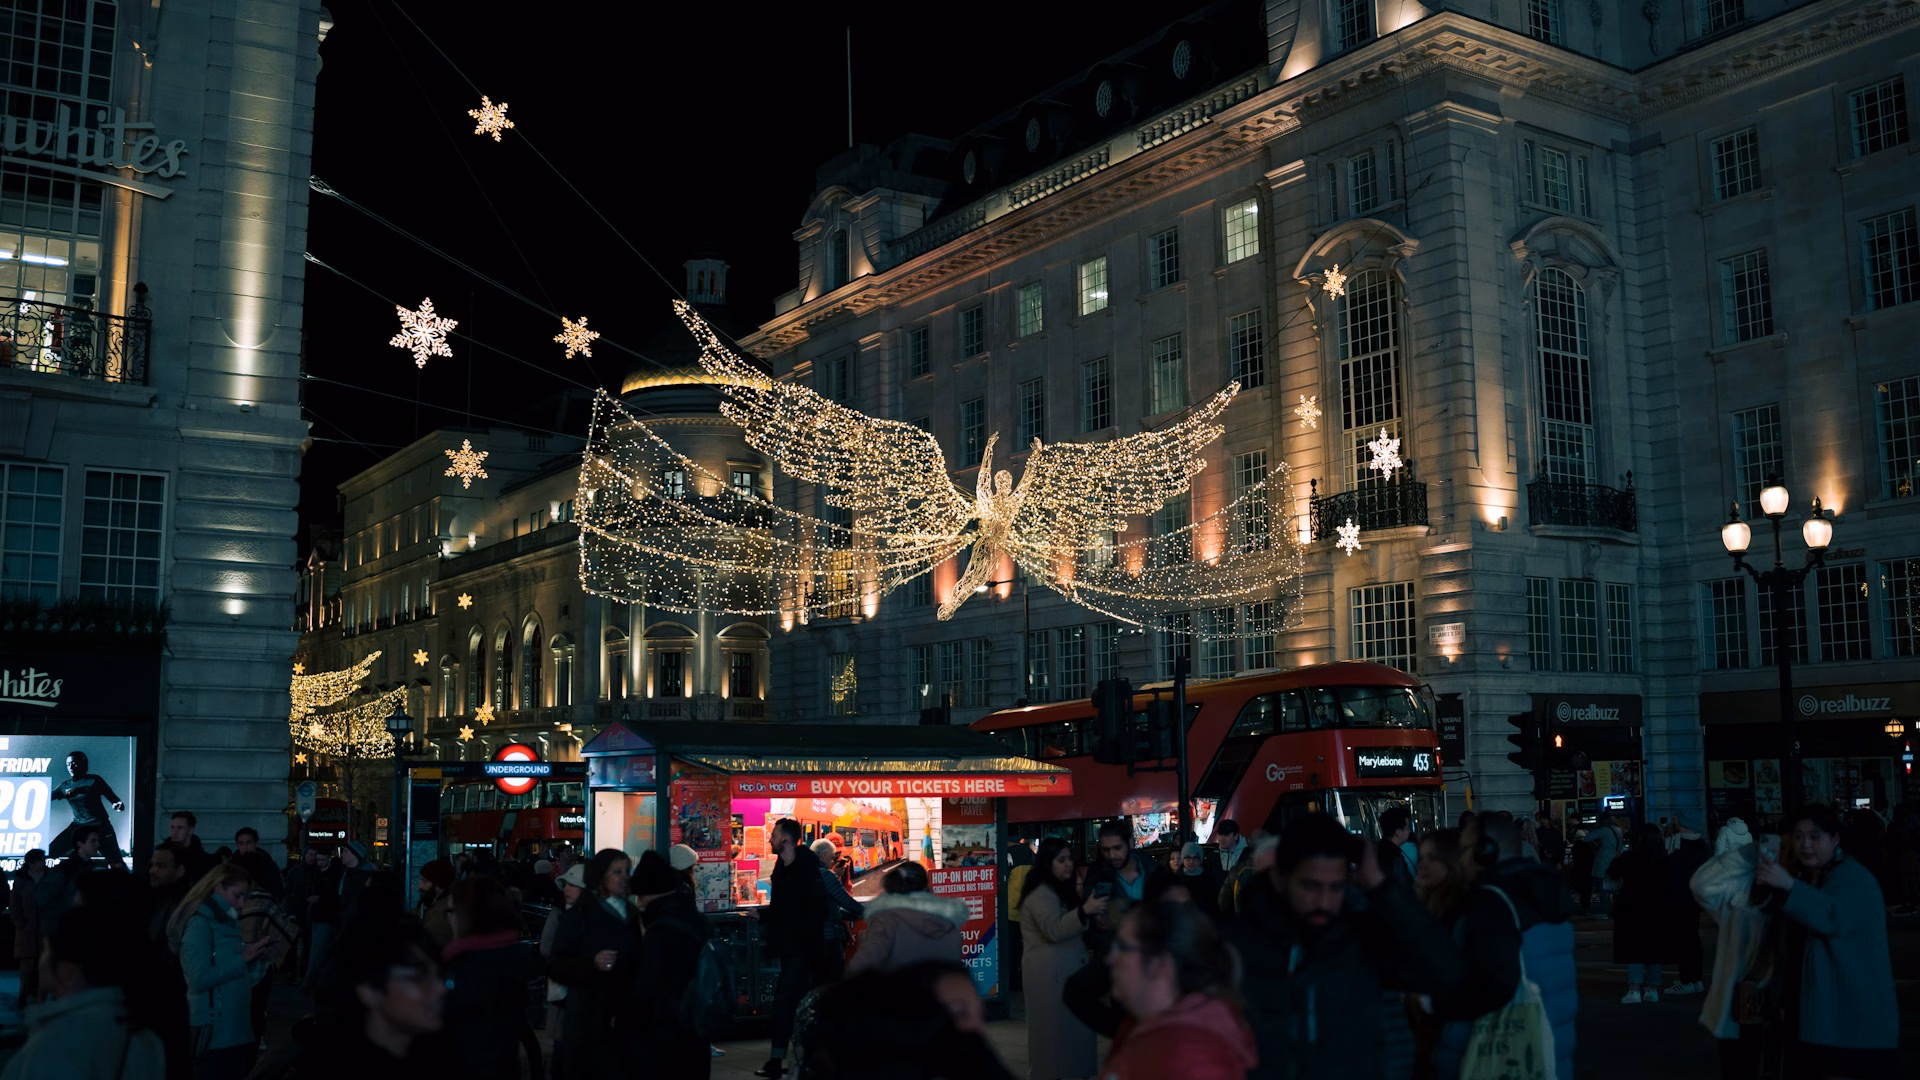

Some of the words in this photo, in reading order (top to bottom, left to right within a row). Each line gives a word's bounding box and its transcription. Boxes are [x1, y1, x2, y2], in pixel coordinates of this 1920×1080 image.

[0, 667, 63, 698] hites
[1820, 694, 1891, 713] realbuzz
[1572, 703, 1620, 721] realbuzz
[1437, 716, 1462, 725] CYDESDALE
[0, 757, 51, 773] FRIDAY
[1358, 755, 1403, 769] Marylebone
[1412, 753, 1430, 771] 453
[485, 764, 550, 774] UNDERGROUND
[739, 782, 754, 792] Hop
[756, 782, 766, 791] On
[769, 782, 784, 792] Hop
[785, 782, 797, 791] Off
[811, 780, 843, 794] BUY
[847, 780, 892, 794] YOUR
[896, 780, 960, 794] TICKETS
[965, 779, 1005, 793] HERE
[960, 805, 984, 816] TRAVEL
[560, 815, 576, 823] Acton
[338, 831, 346, 839] 19
[931, 870, 961, 883] HOP-ON
[962, 869, 994, 882] HOP-OFF
[932, 884, 965, 895] SIGHTSEEING
[966, 883, 976, 892] BUS
[977, 882, 994, 891] TOURS
[961, 944, 985, 955] OUR
